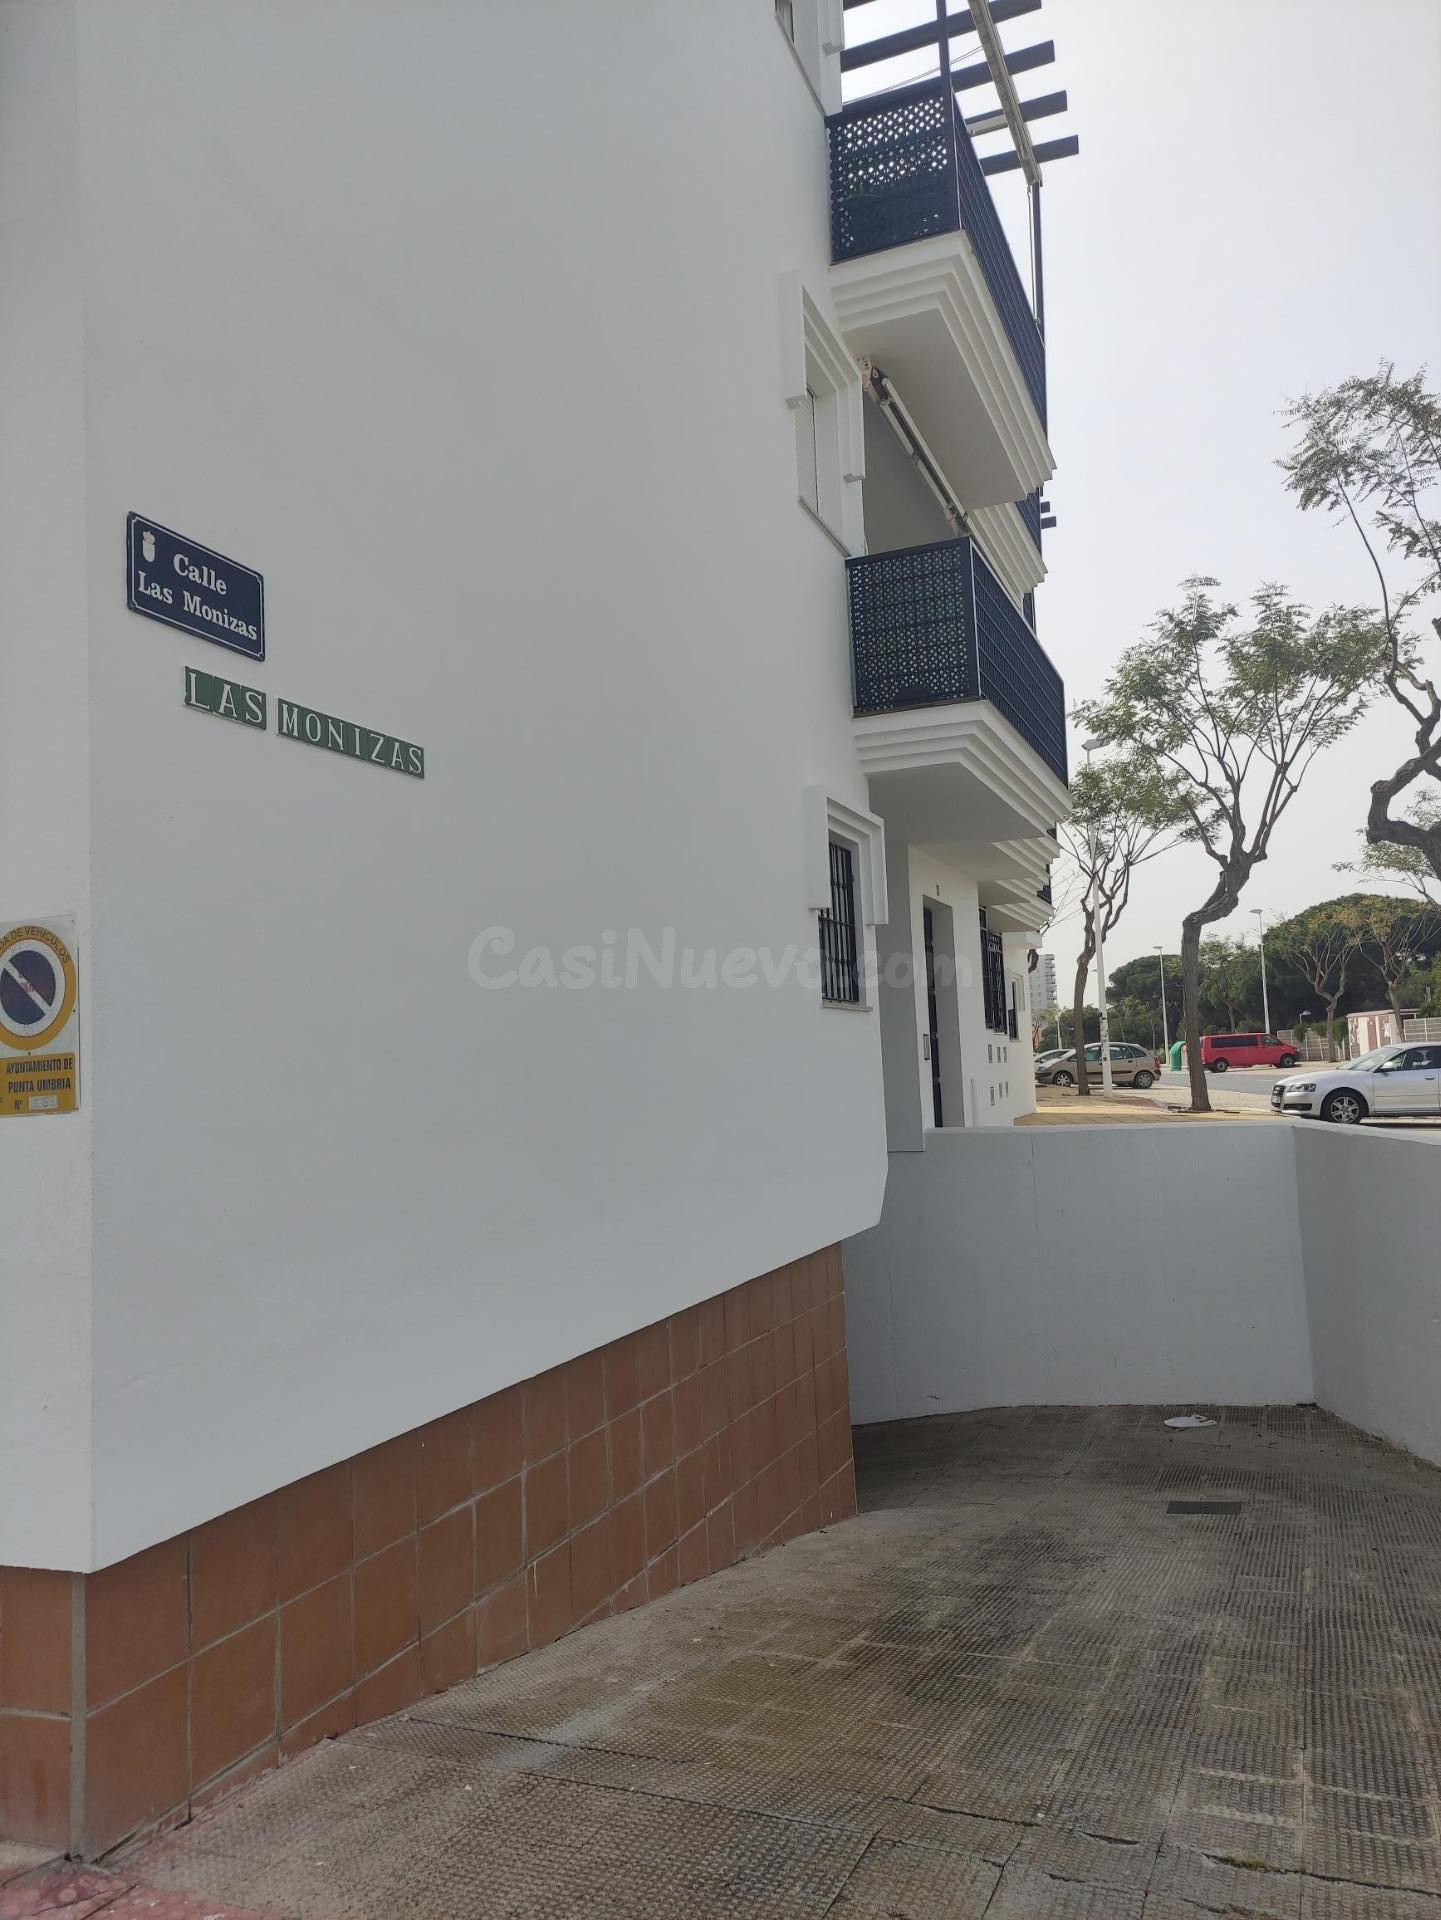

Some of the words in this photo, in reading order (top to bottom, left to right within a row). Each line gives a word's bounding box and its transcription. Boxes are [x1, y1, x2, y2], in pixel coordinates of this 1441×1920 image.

[173, 553, 227, 595] Calle
[138, 570, 173, 604] Las
[183, 590, 257, 641] Monizas
[189, 672, 264, 723] LAS
[282, 703, 423, 774] MONIZAS
[10, 928, 23, 939] DE
[7, 1058, 61, 1074] AYUNTAMIENTO
[64, 1058, 72, 1070] DE
[8, 1080, 34, 1093] PUNTA
[37, 1078, 71, 1091] UMBRIA
